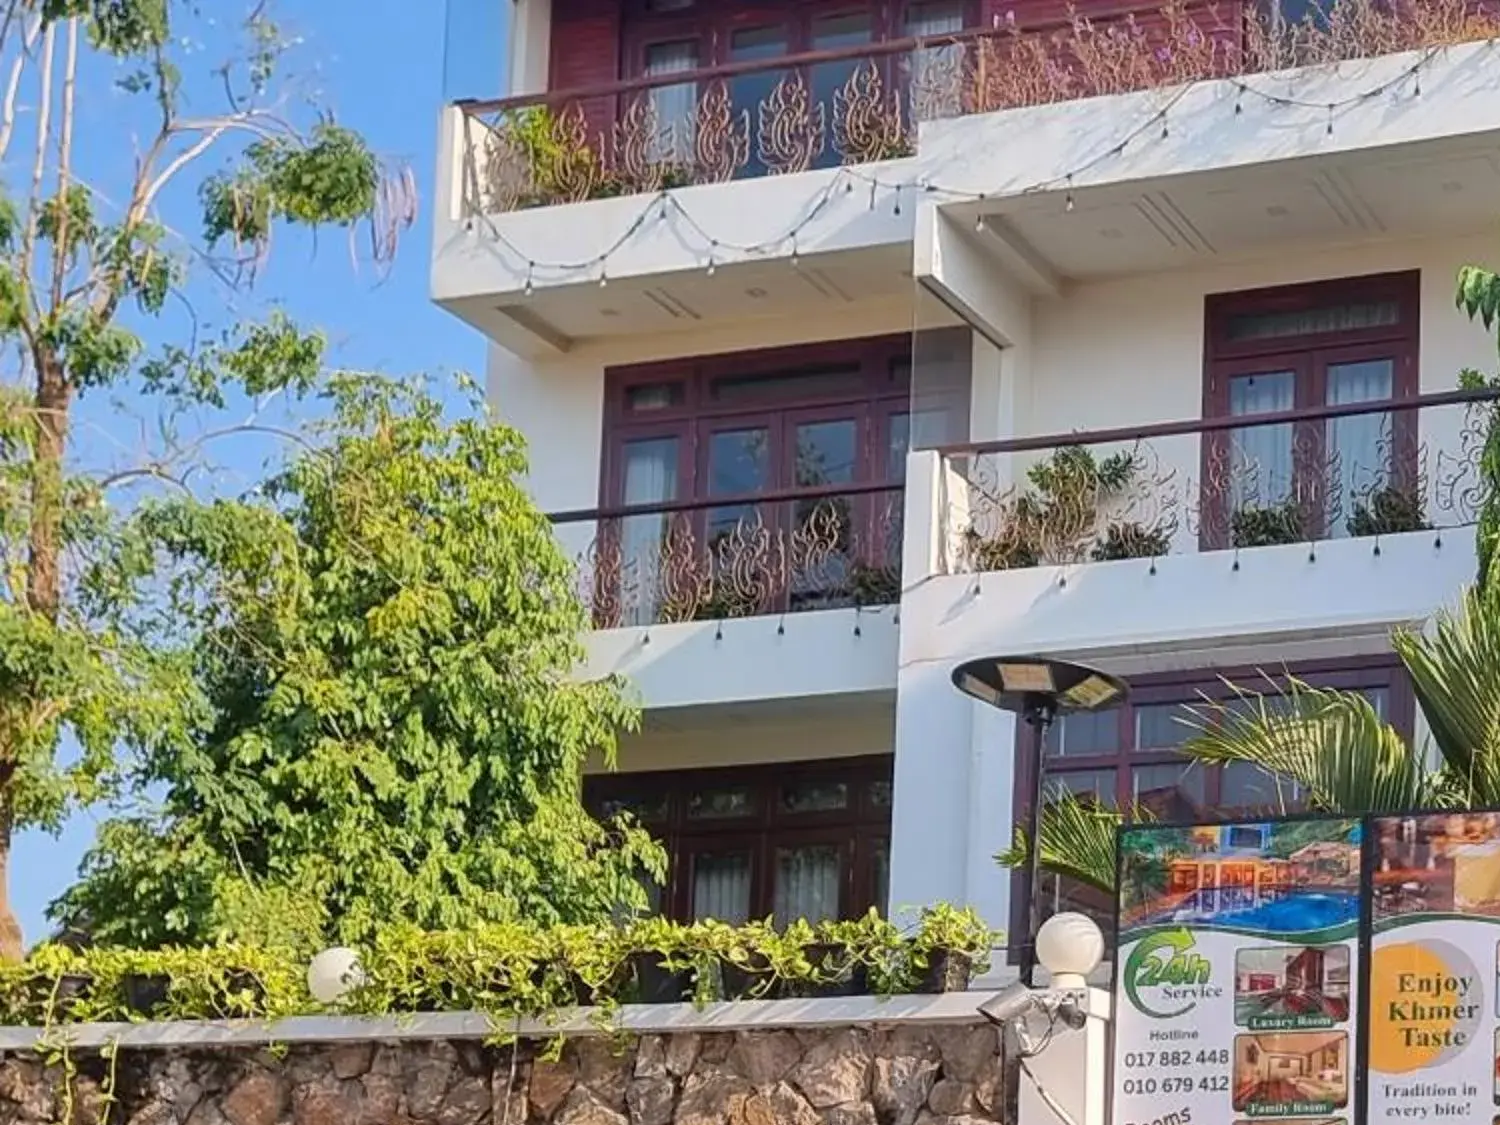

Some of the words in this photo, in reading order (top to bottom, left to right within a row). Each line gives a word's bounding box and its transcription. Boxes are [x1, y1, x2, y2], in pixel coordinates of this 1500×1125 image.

[1136, 953, 1211, 986] 24h
[1162, 985, 1223, 999] Service
[1398, 973, 1473, 997] Enjoy
[1389, 1001, 1480, 1020] Khmer
[1149, 1029, 1199, 1040] Hotline
[1399, 1027, 1467, 1046] Taste
[1125, 1052, 1155, 1068] 017
[1159, 1051, 1191, 1066] 882
[1196, 1049, 1229, 1065] 448
[1123, 1078, 1157, 1094] 010
[1162, 1077, 1193, 1093] 679
[1198, 1076, 1229, 1091] 412
[1382, 1083, 1457, 1097] Tradition
[1462, 1082, 1477, 1096] in
[1251, 1103, 1289, 1115] Family
[1293, 1102, 1328, 1112] Room
[1386, 1106, 1427, 1119] every
[1435, 1102, 1471, 1116] bite!
